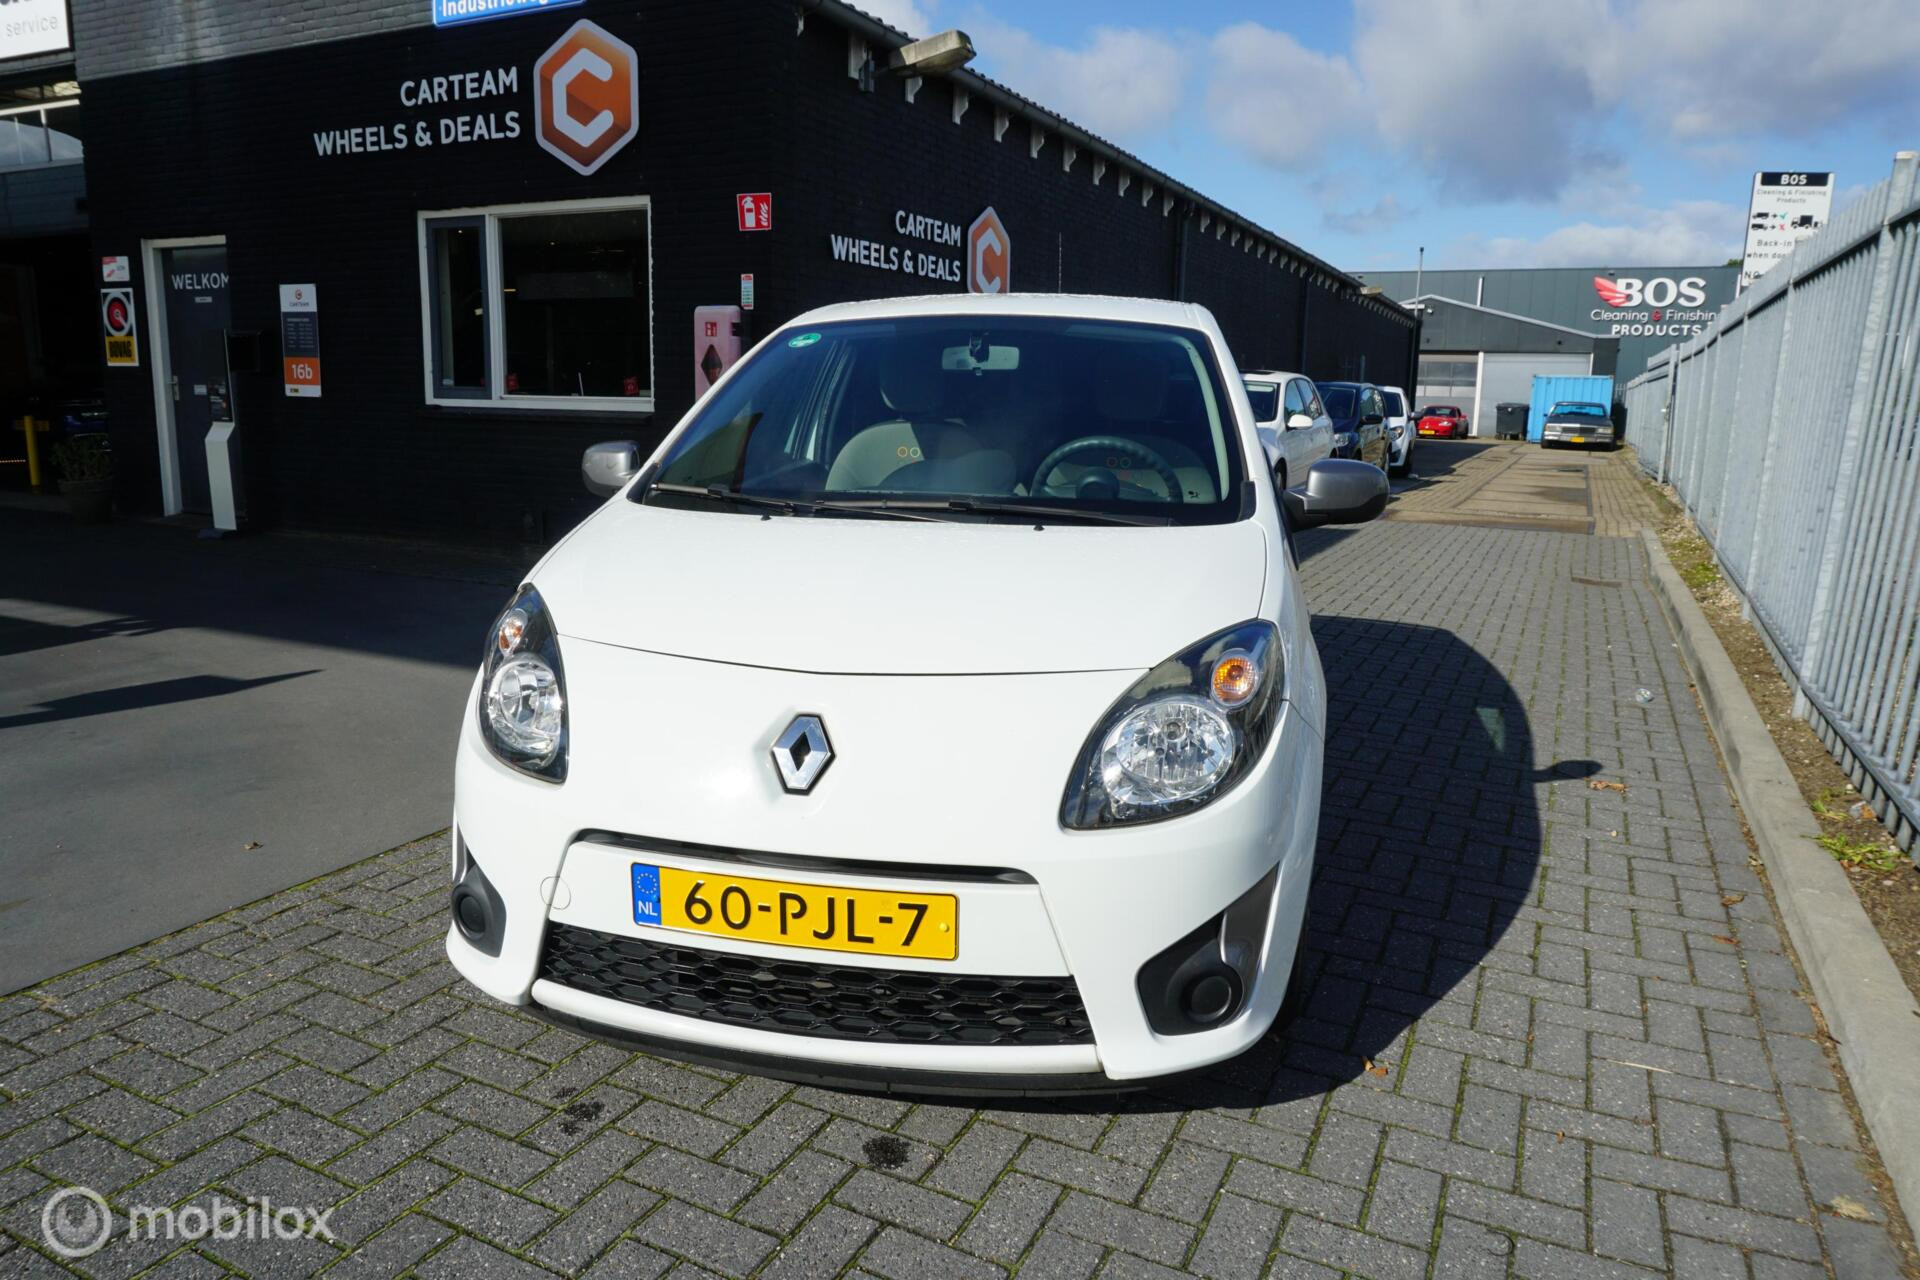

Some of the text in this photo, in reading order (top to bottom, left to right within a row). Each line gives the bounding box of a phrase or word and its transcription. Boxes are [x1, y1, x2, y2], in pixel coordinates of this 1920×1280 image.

[442, 0, 548, 17] Industr
[6, 15, 58, 38] service
[400, 66, 518, 107] CARTEAM
[314, 111, 520, 156] WHEELS & DEALS
[1781, 174, 1807, 185] BOS
[895, 210, 961, 247] CARTEAM
[831, 234, 961, 282] WHEELS & DEALS
[1616, 277, 1706, 308] BOS
[1591, 309, 1720, 323] Cleaning & Finishin
[1612, 325, 1702, 336] PRODUCTS
[291, 364, 313, 381] 16b
[638, 880, 928, 947] NL 60-PJL-7
